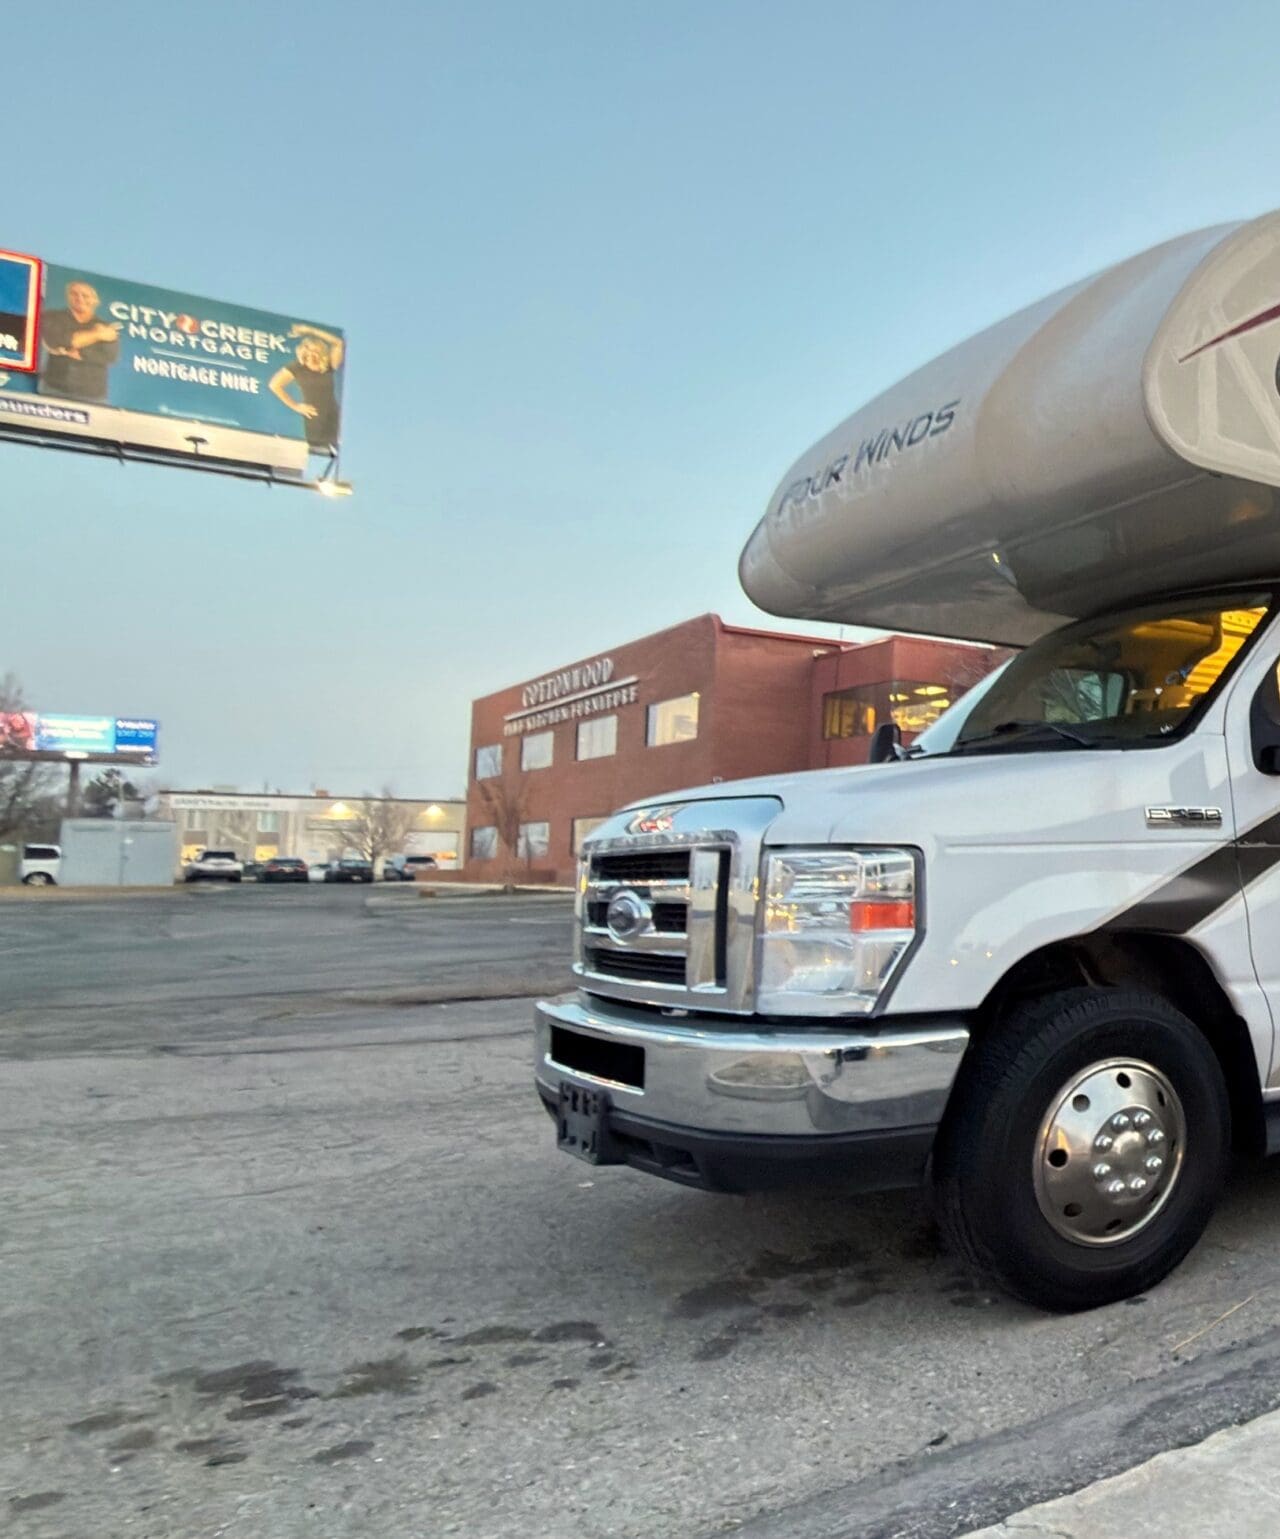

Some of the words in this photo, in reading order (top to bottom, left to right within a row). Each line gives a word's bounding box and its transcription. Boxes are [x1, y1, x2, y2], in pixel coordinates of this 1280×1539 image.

[109, 301, 177, 329] CITY
[200, 319, 287, 353] CREEK
[128, 322, 270, 364] MORTGAGE
[133, 355, 218, 386] MORTGAGE
[777, 454, 849, 517] FOUR
[853, 398, 962, 473] WINDS
